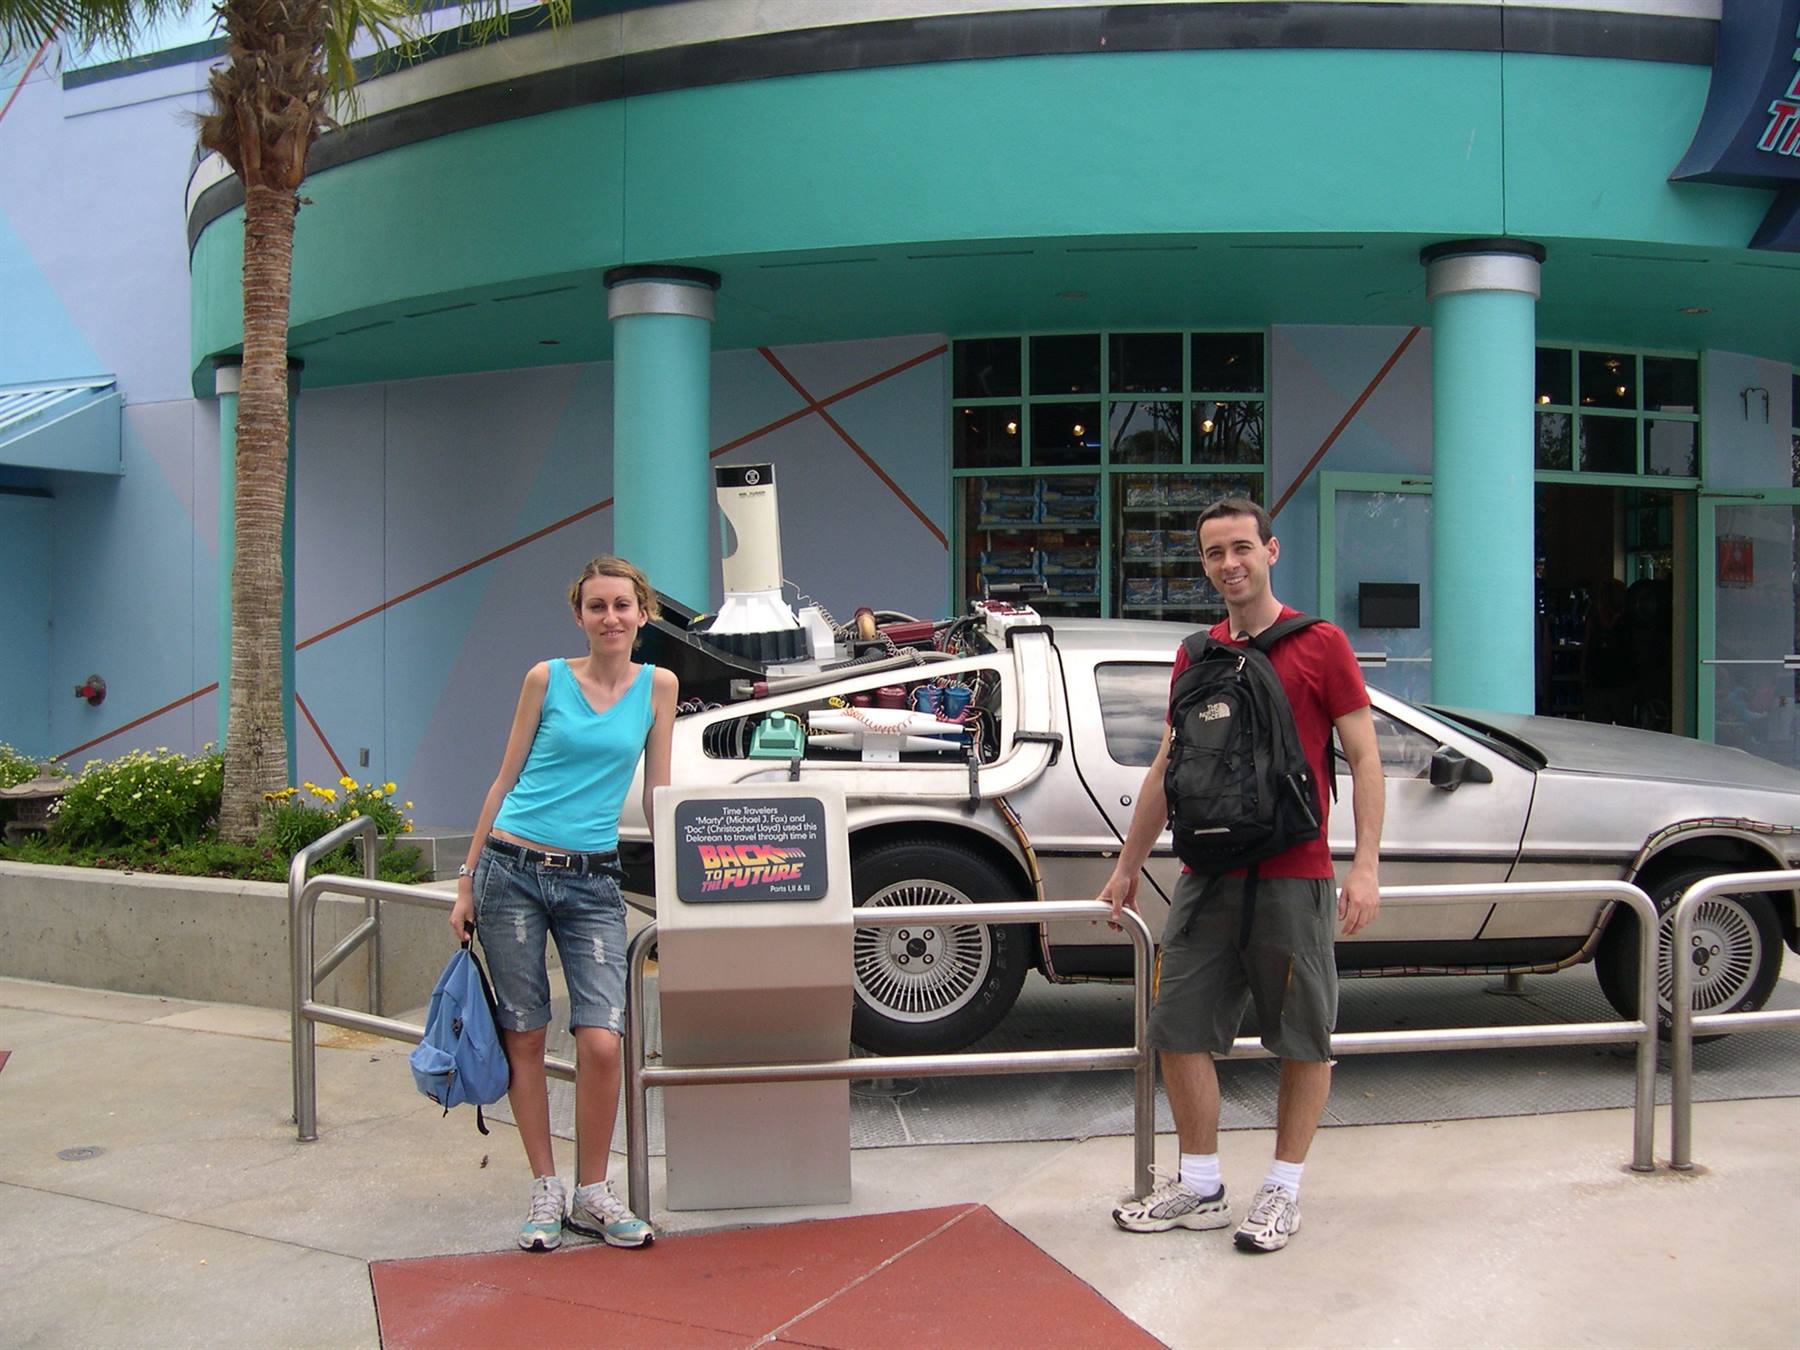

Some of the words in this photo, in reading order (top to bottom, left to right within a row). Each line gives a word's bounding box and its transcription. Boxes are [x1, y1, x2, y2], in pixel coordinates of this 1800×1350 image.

[722, 807, 741, 815] Time
[743, 806, 778, 815] Travelers
[695, 816, 724, 825] "Marty"
[726, 815, 761, 825] (Michael
[762, 815, 769, 823] J.
[771, 815, 788, 824] Fox)
[789, 815, 805, 823] and
[684, 825, 706, 834] "Doc"
[707, 824, 755, 834] (Christopher
[756, 823, 781, 833] Lloyd)
[782, 823, 802, 831] used
[803, 823, 817, 831] this
[724, 834, 733, 842] to
[734, 833, 756, 842] travel
[758, 833, 788, 842] through
[790, 832, 807, 840] time
[698, 845, 805, 869] BACK
[705, 869, 723, 881] TO
[721, 862, 804, 890] FUTURE
[701, 880, 722, 893] THE
